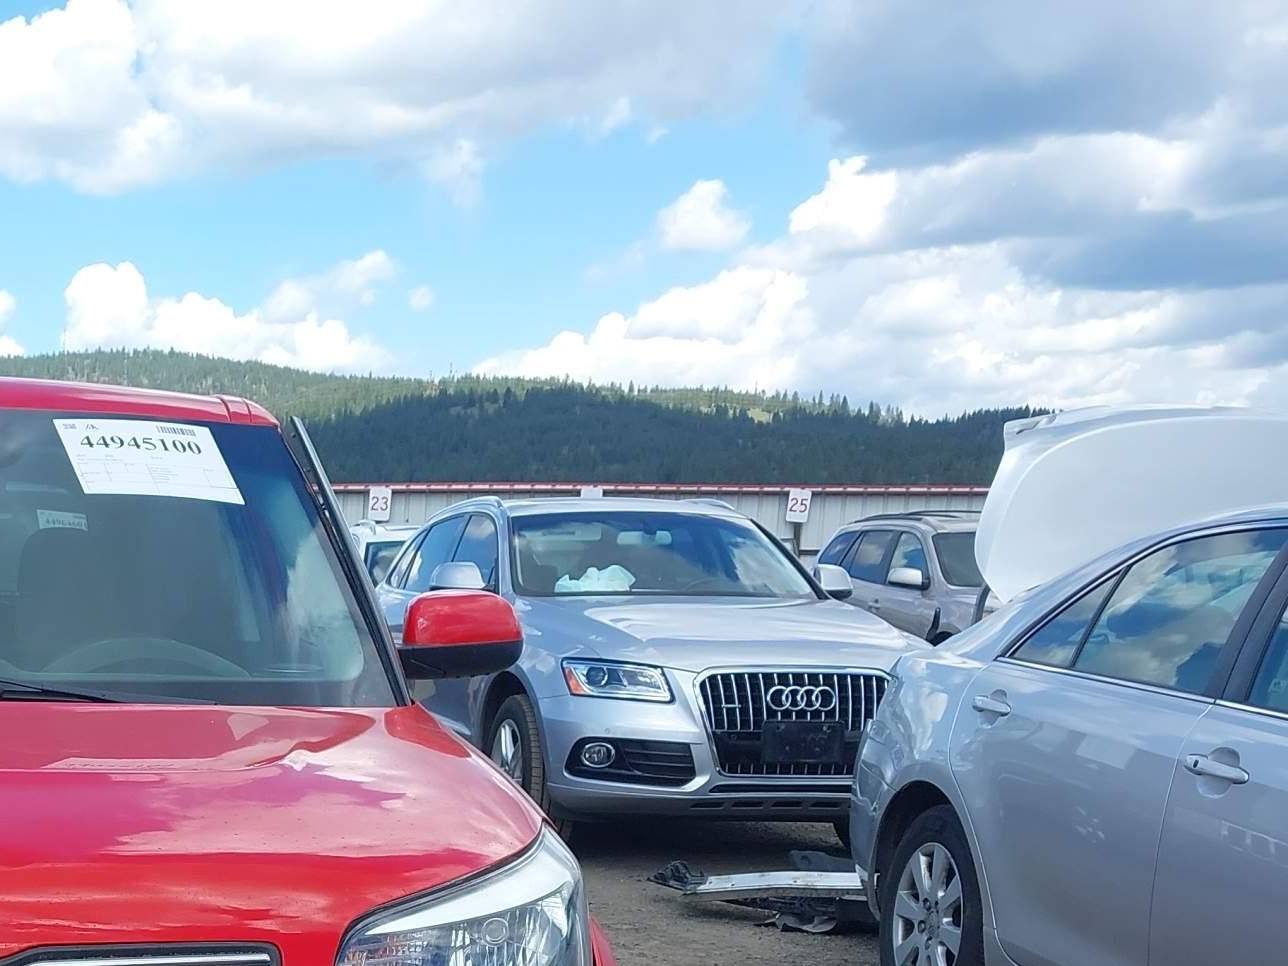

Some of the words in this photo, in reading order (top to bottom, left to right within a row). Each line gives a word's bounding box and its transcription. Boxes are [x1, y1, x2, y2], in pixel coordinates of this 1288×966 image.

[80, 435, 202, 455] 44945100
[371, 496, 389, 511] 23
[789, 497, 808, 513] 25
